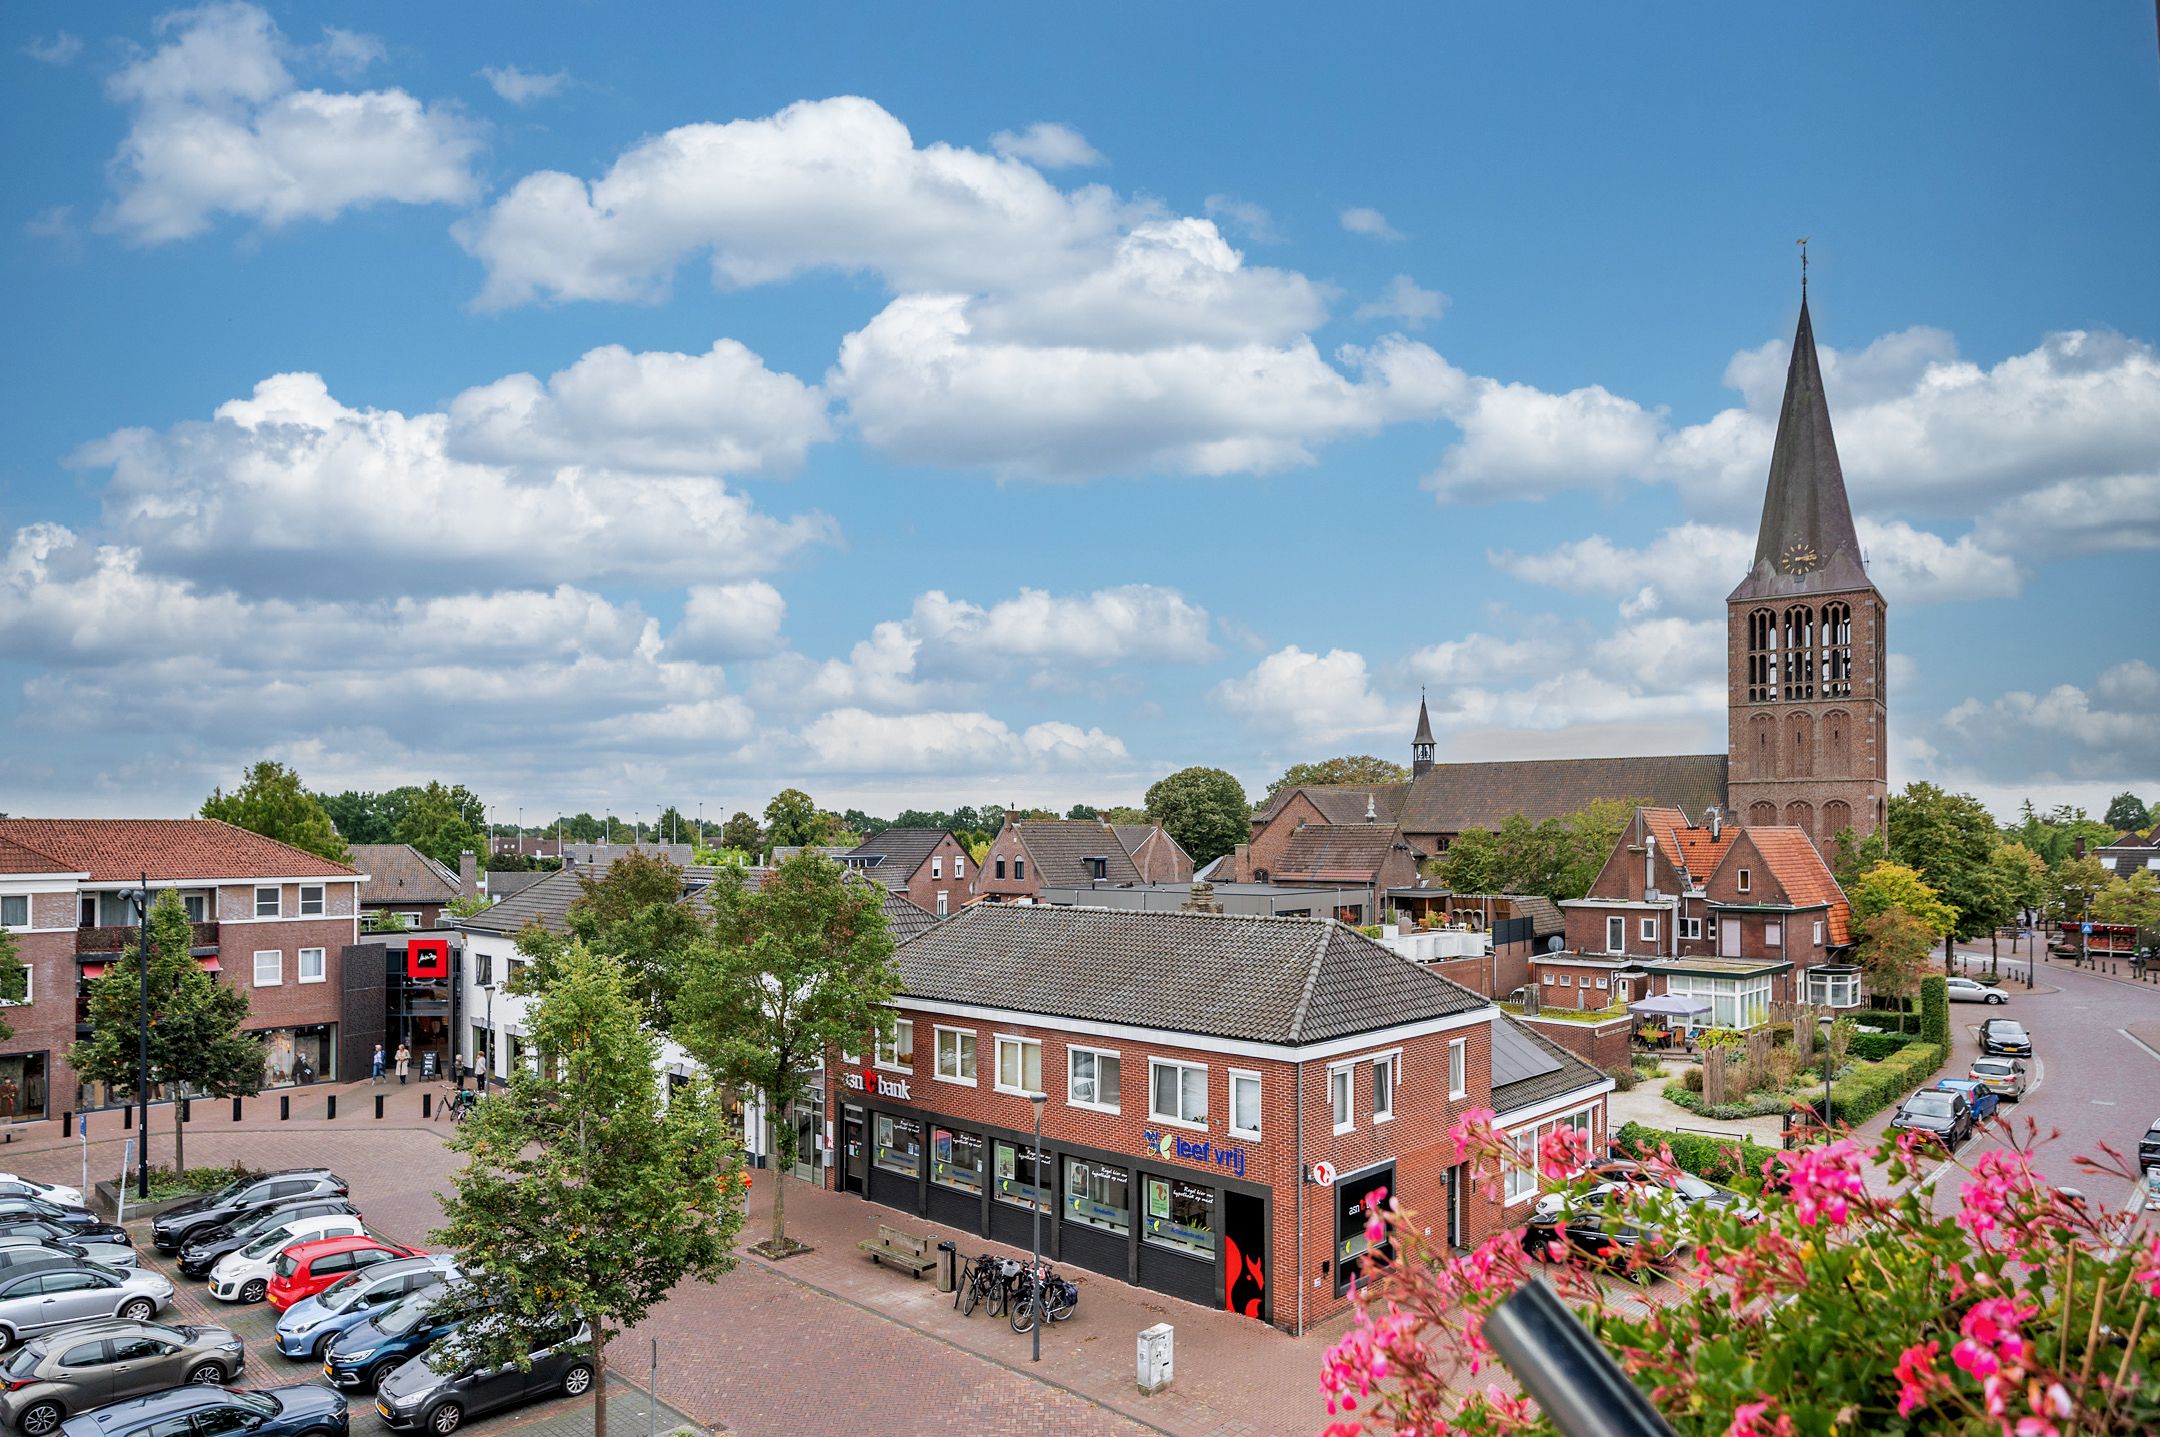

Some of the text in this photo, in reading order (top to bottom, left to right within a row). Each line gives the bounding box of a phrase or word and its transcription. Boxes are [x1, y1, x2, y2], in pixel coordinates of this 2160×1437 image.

[877, 1075, 911, 1100] bank
[1176, 1136, 1246, 1177] leef vrij
[1348, 1204, 1360, 1216] asn
